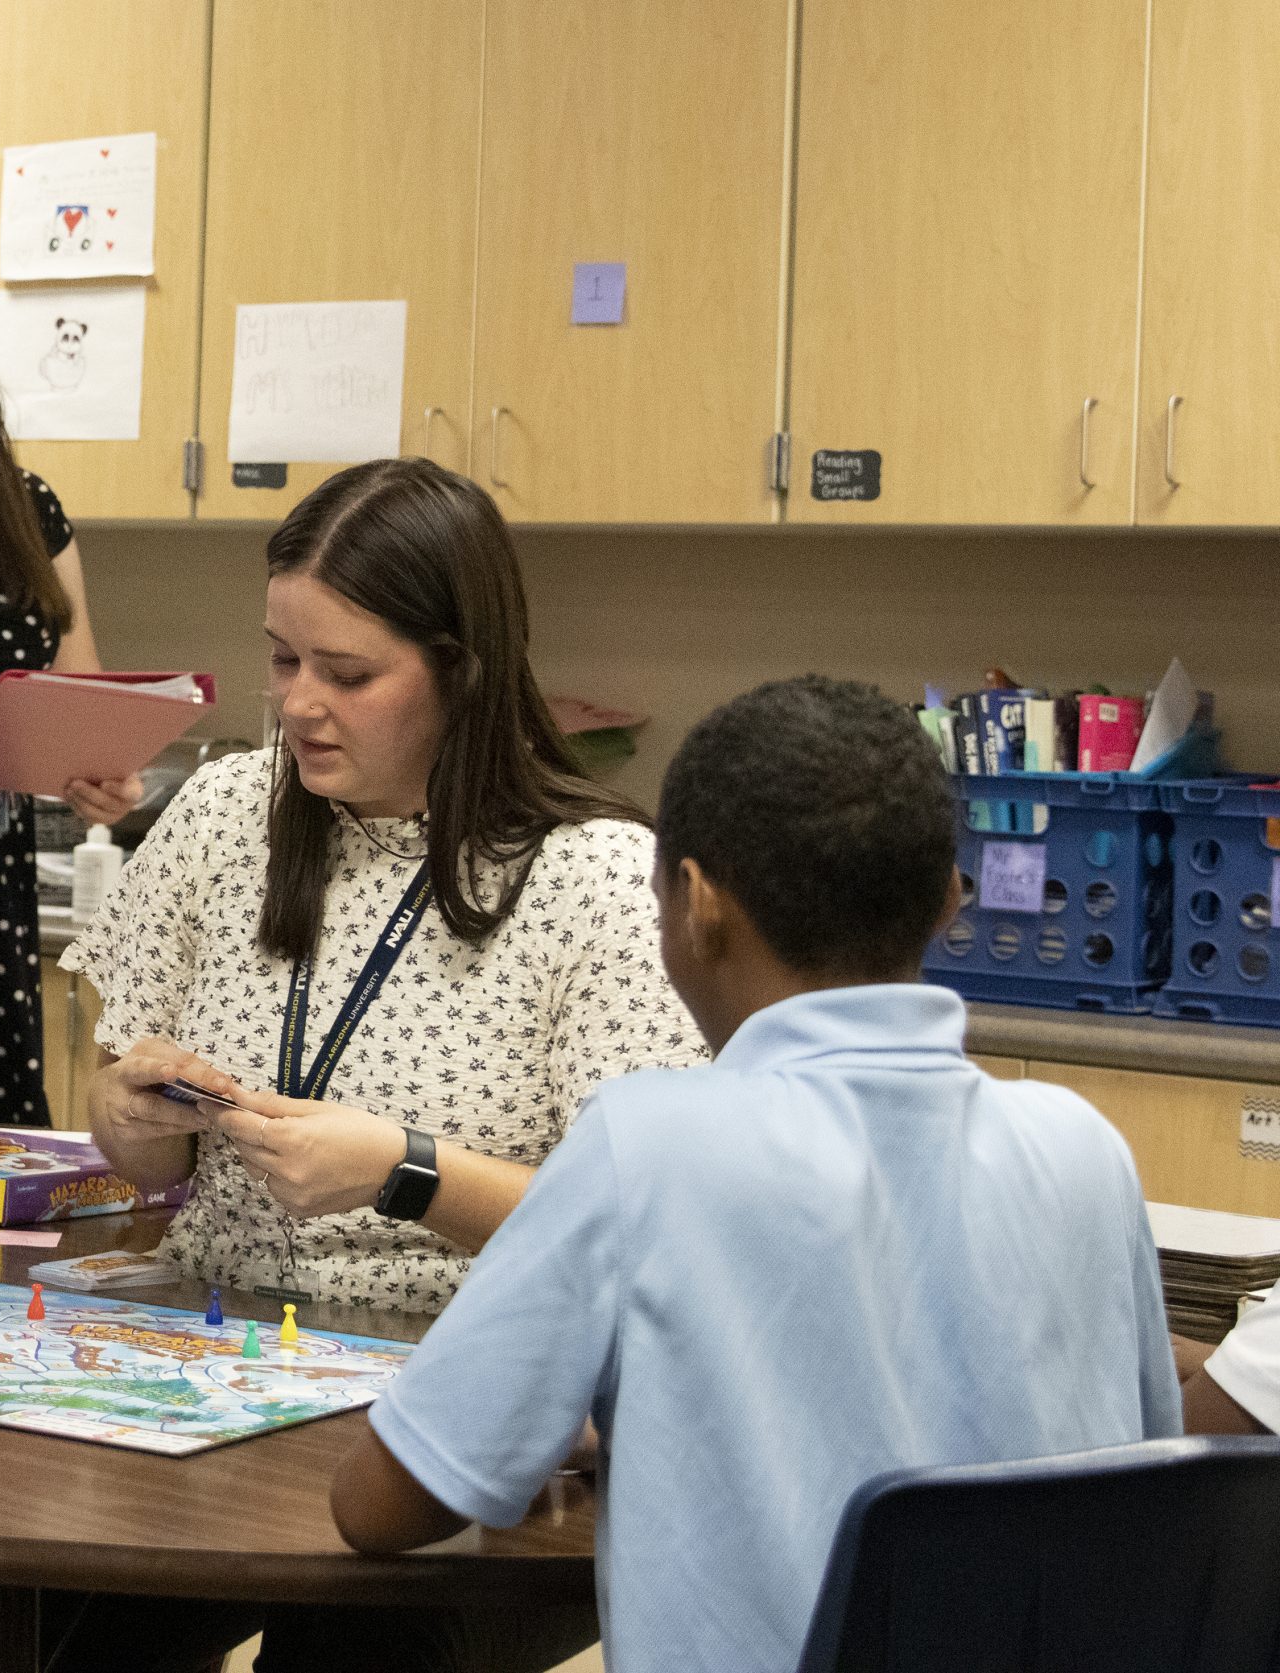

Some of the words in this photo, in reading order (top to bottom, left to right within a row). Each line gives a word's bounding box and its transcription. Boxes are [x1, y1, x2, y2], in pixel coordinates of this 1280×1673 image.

[816, 452, 863, 476] Reading
[816, 470, 850, 485] Small
[821, 484, 865, 499] Groups
[329, 1020, 352, 1059] ARIZONA
[348, 970, 381, 1020] UNIVERSITY
[385, 908, 415, 949] NAU
[412, 880, 432, 911] NORTH
[288, 992, 300, 1044] NORTHERN
[284, 1046, 293, 1089] ARIZONA
[49, 1176, 107, 1208] HAZARD
